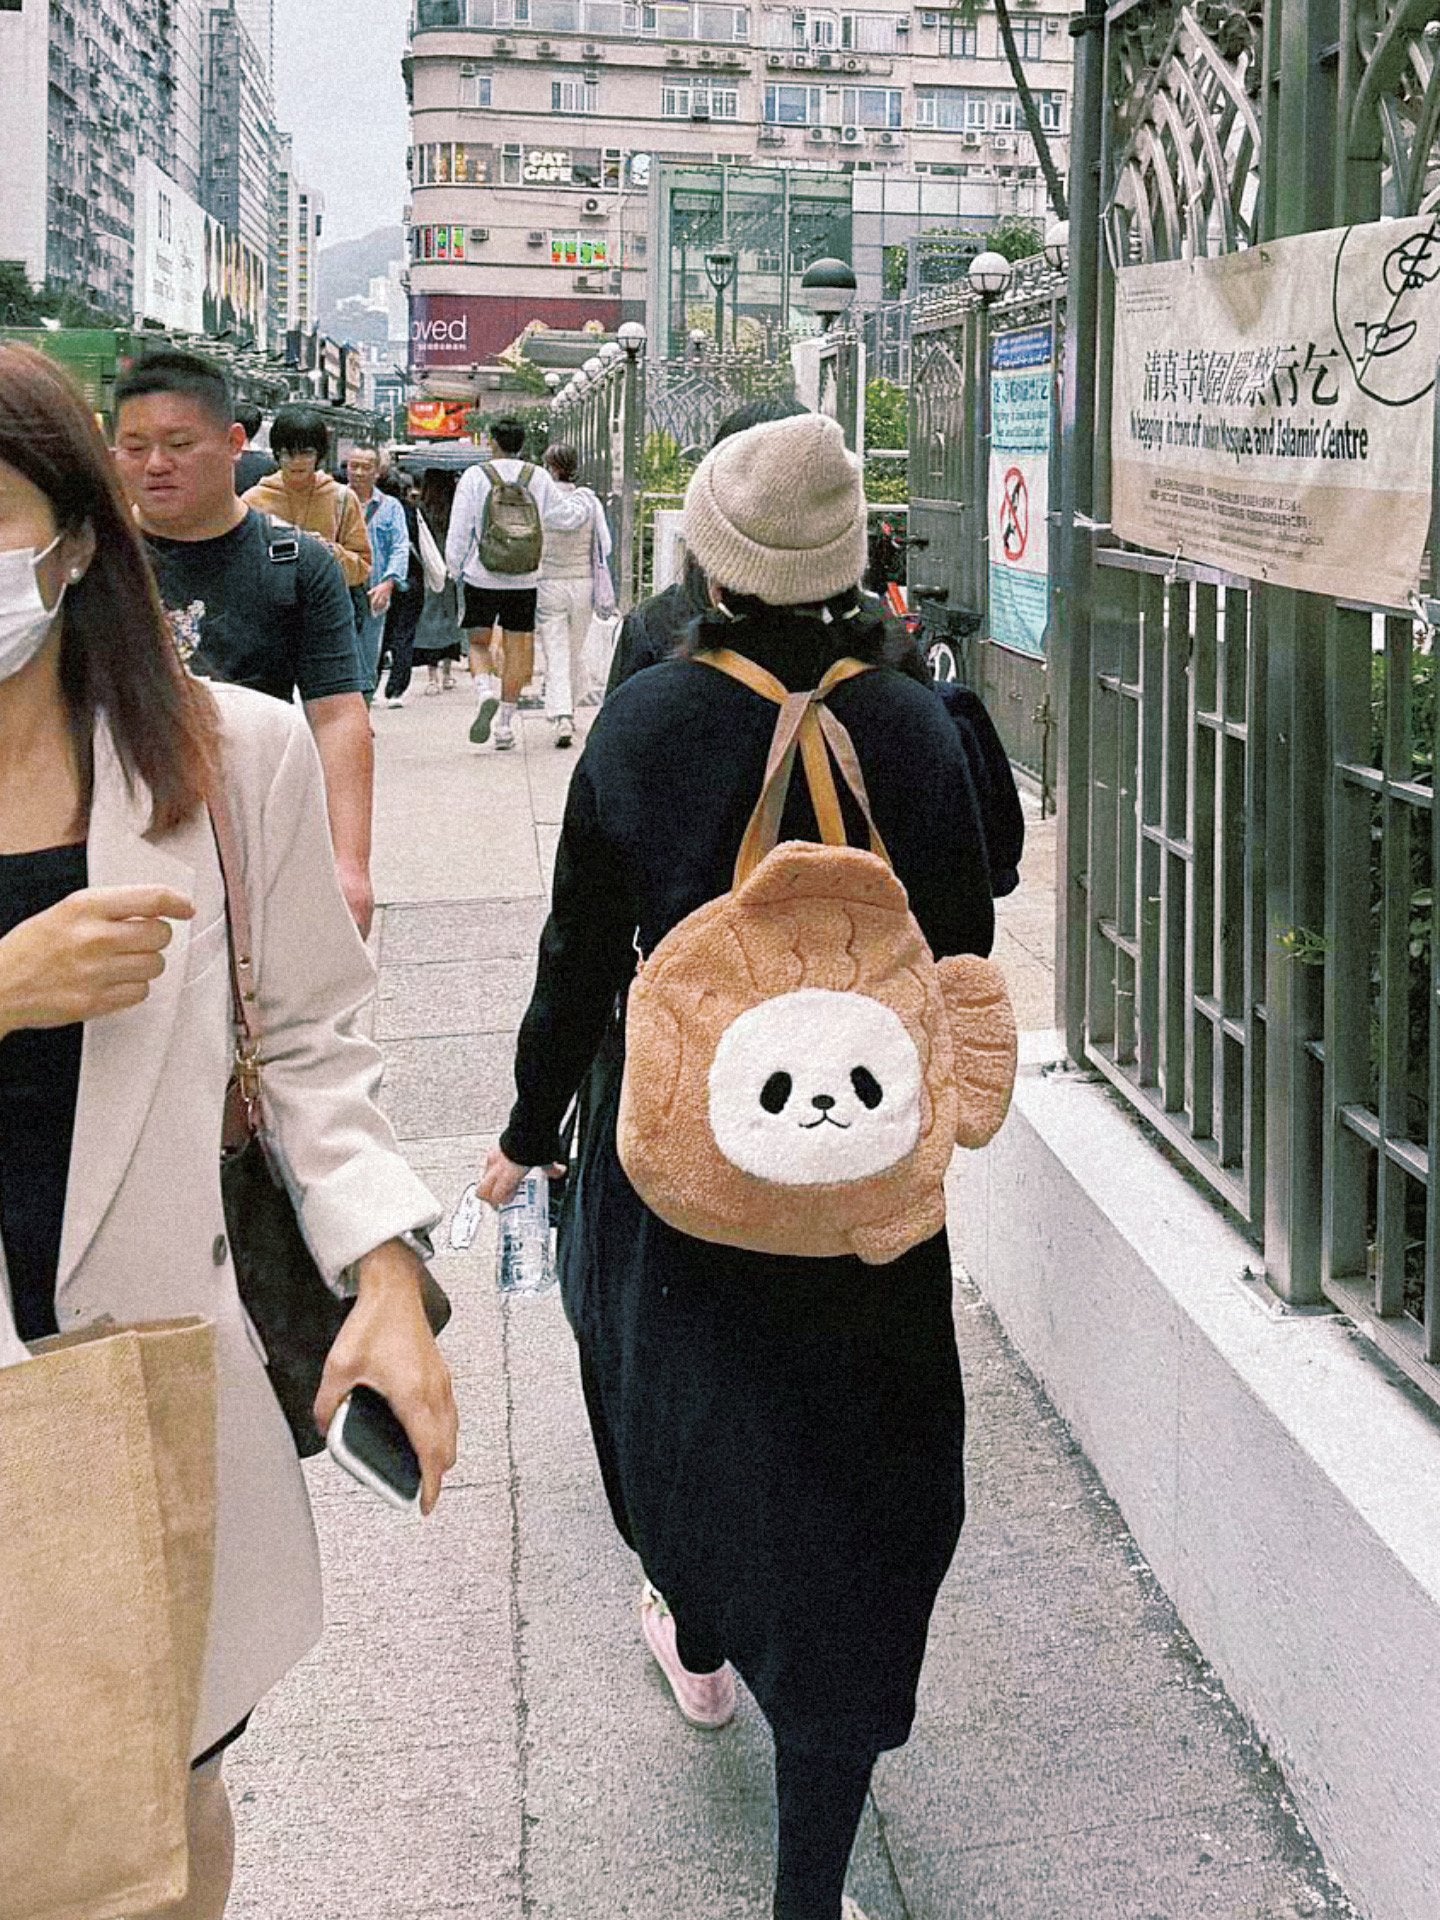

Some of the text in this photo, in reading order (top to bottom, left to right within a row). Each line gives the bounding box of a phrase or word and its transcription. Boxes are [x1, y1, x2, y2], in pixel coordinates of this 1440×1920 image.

[528, 151, 567, 166] CAT
[524, 166, 571, 181] CAFE
[1253, 416, 1274, 455] and
[1276, 417, 1320, 458] Islamic
[1321, 419, 1368, 460] Centre
